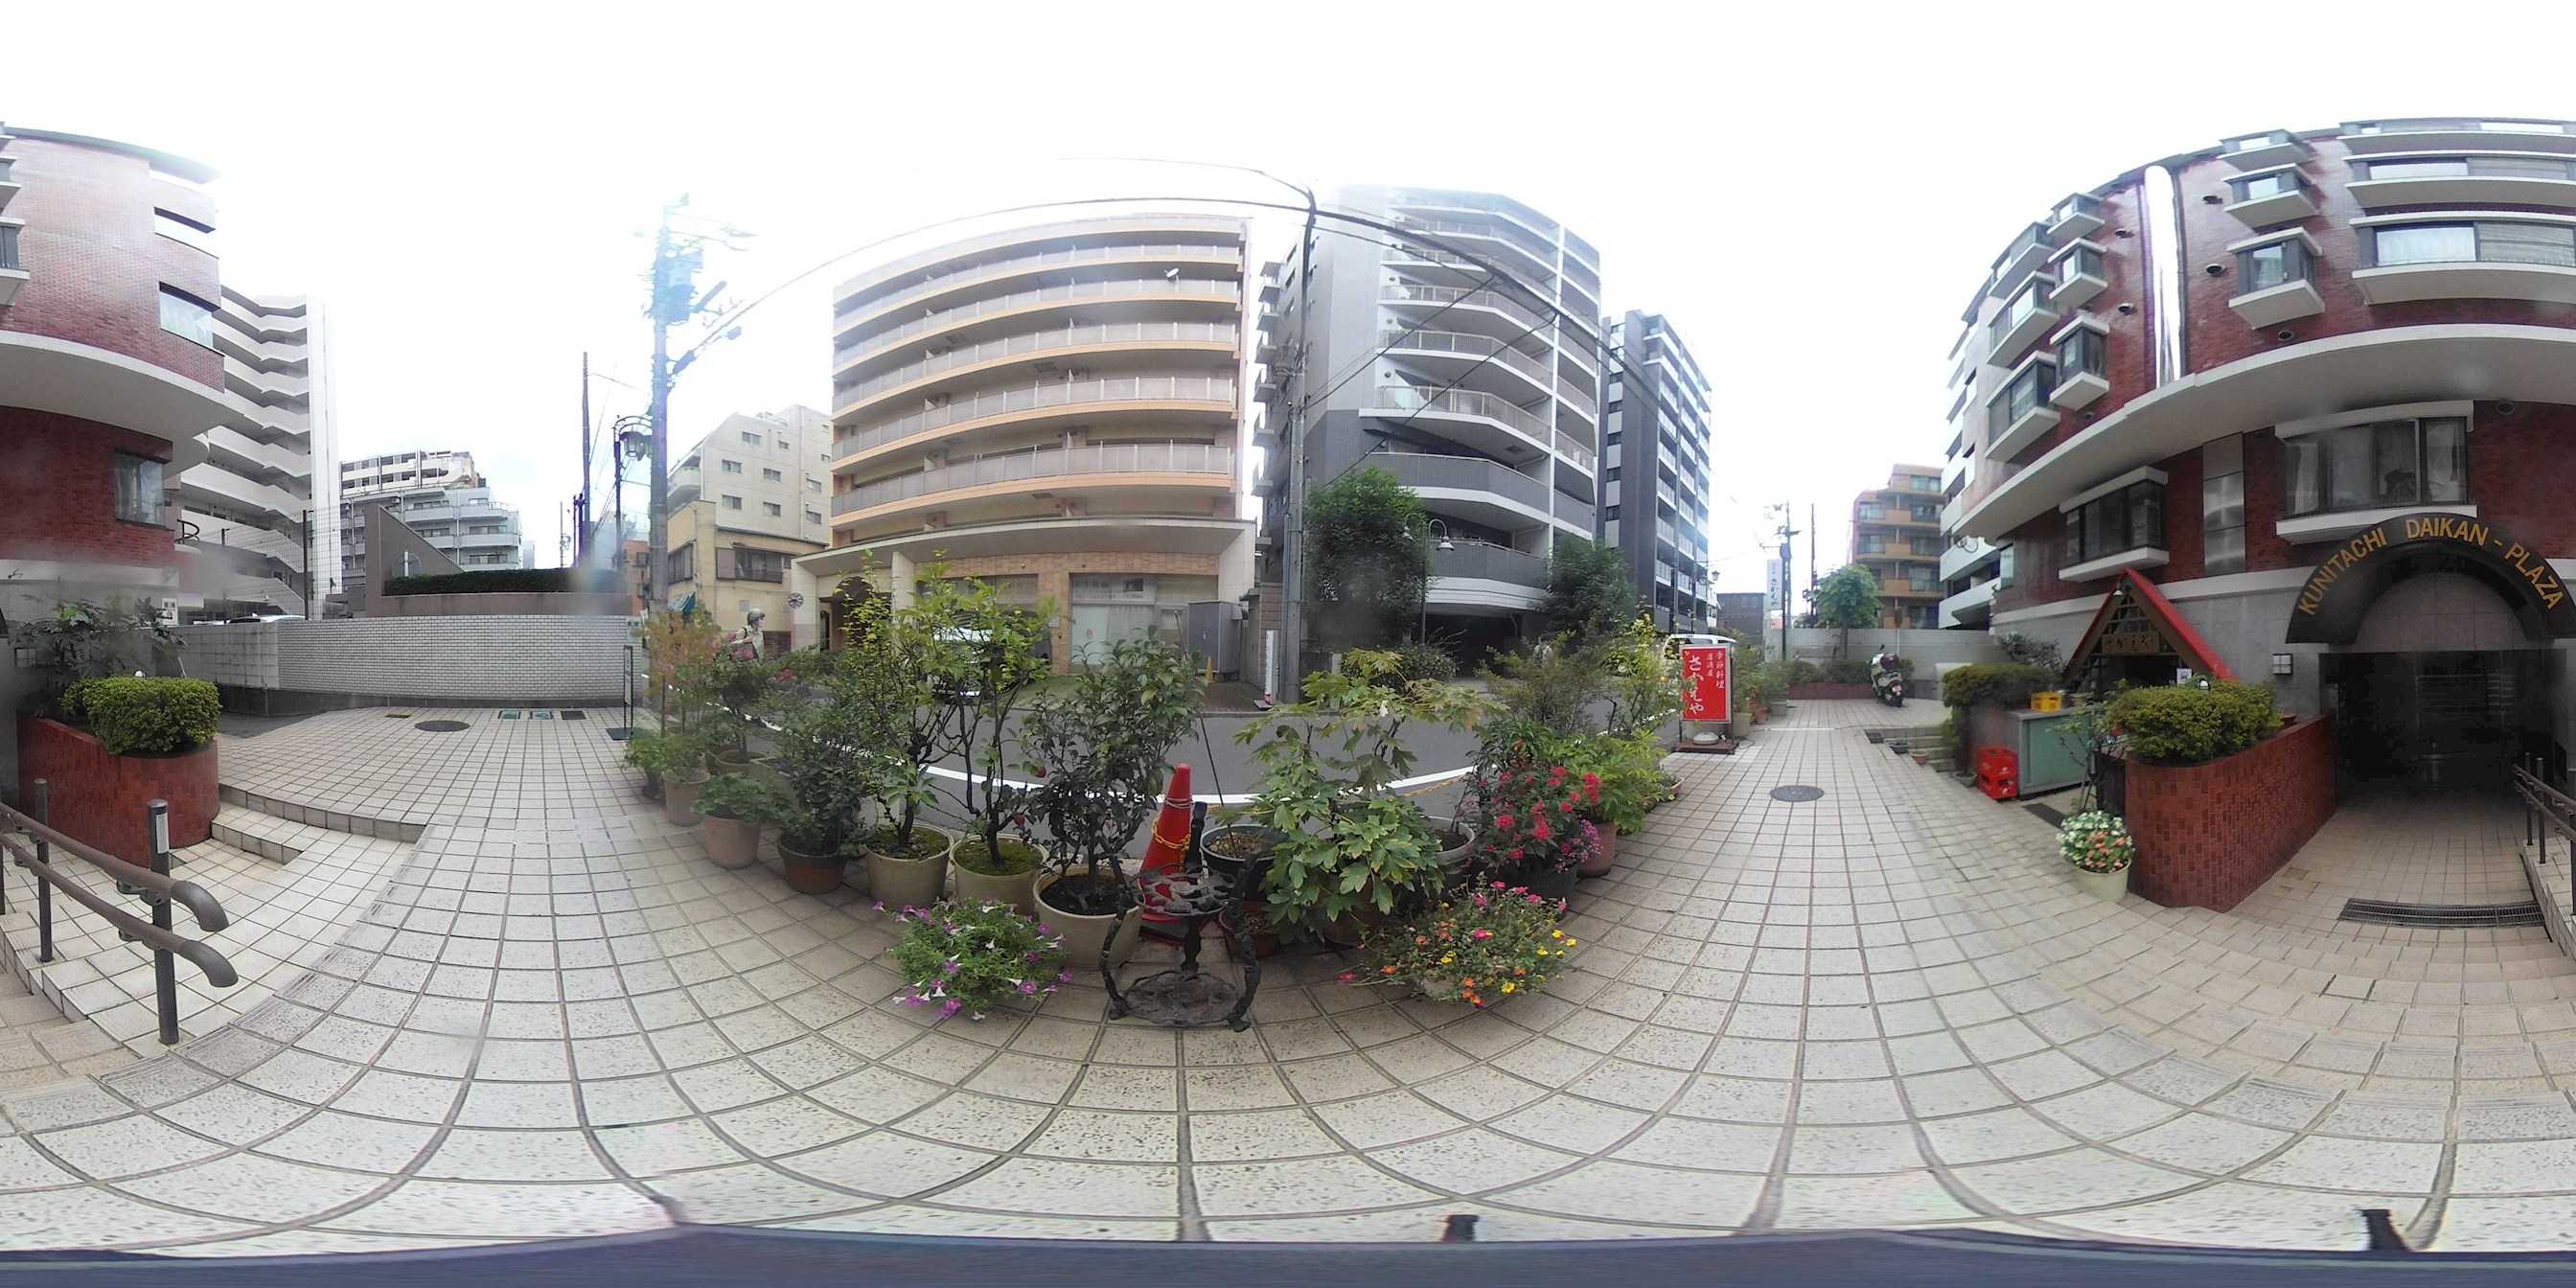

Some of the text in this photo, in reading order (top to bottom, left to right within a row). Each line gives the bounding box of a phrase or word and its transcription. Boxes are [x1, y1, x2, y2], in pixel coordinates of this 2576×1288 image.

[2298, 527, 2388, 615] KUNITACHI
[2404, 518, 2490, 546] DAIKAN
[2504, 542, 2564, 610] PLAZA
